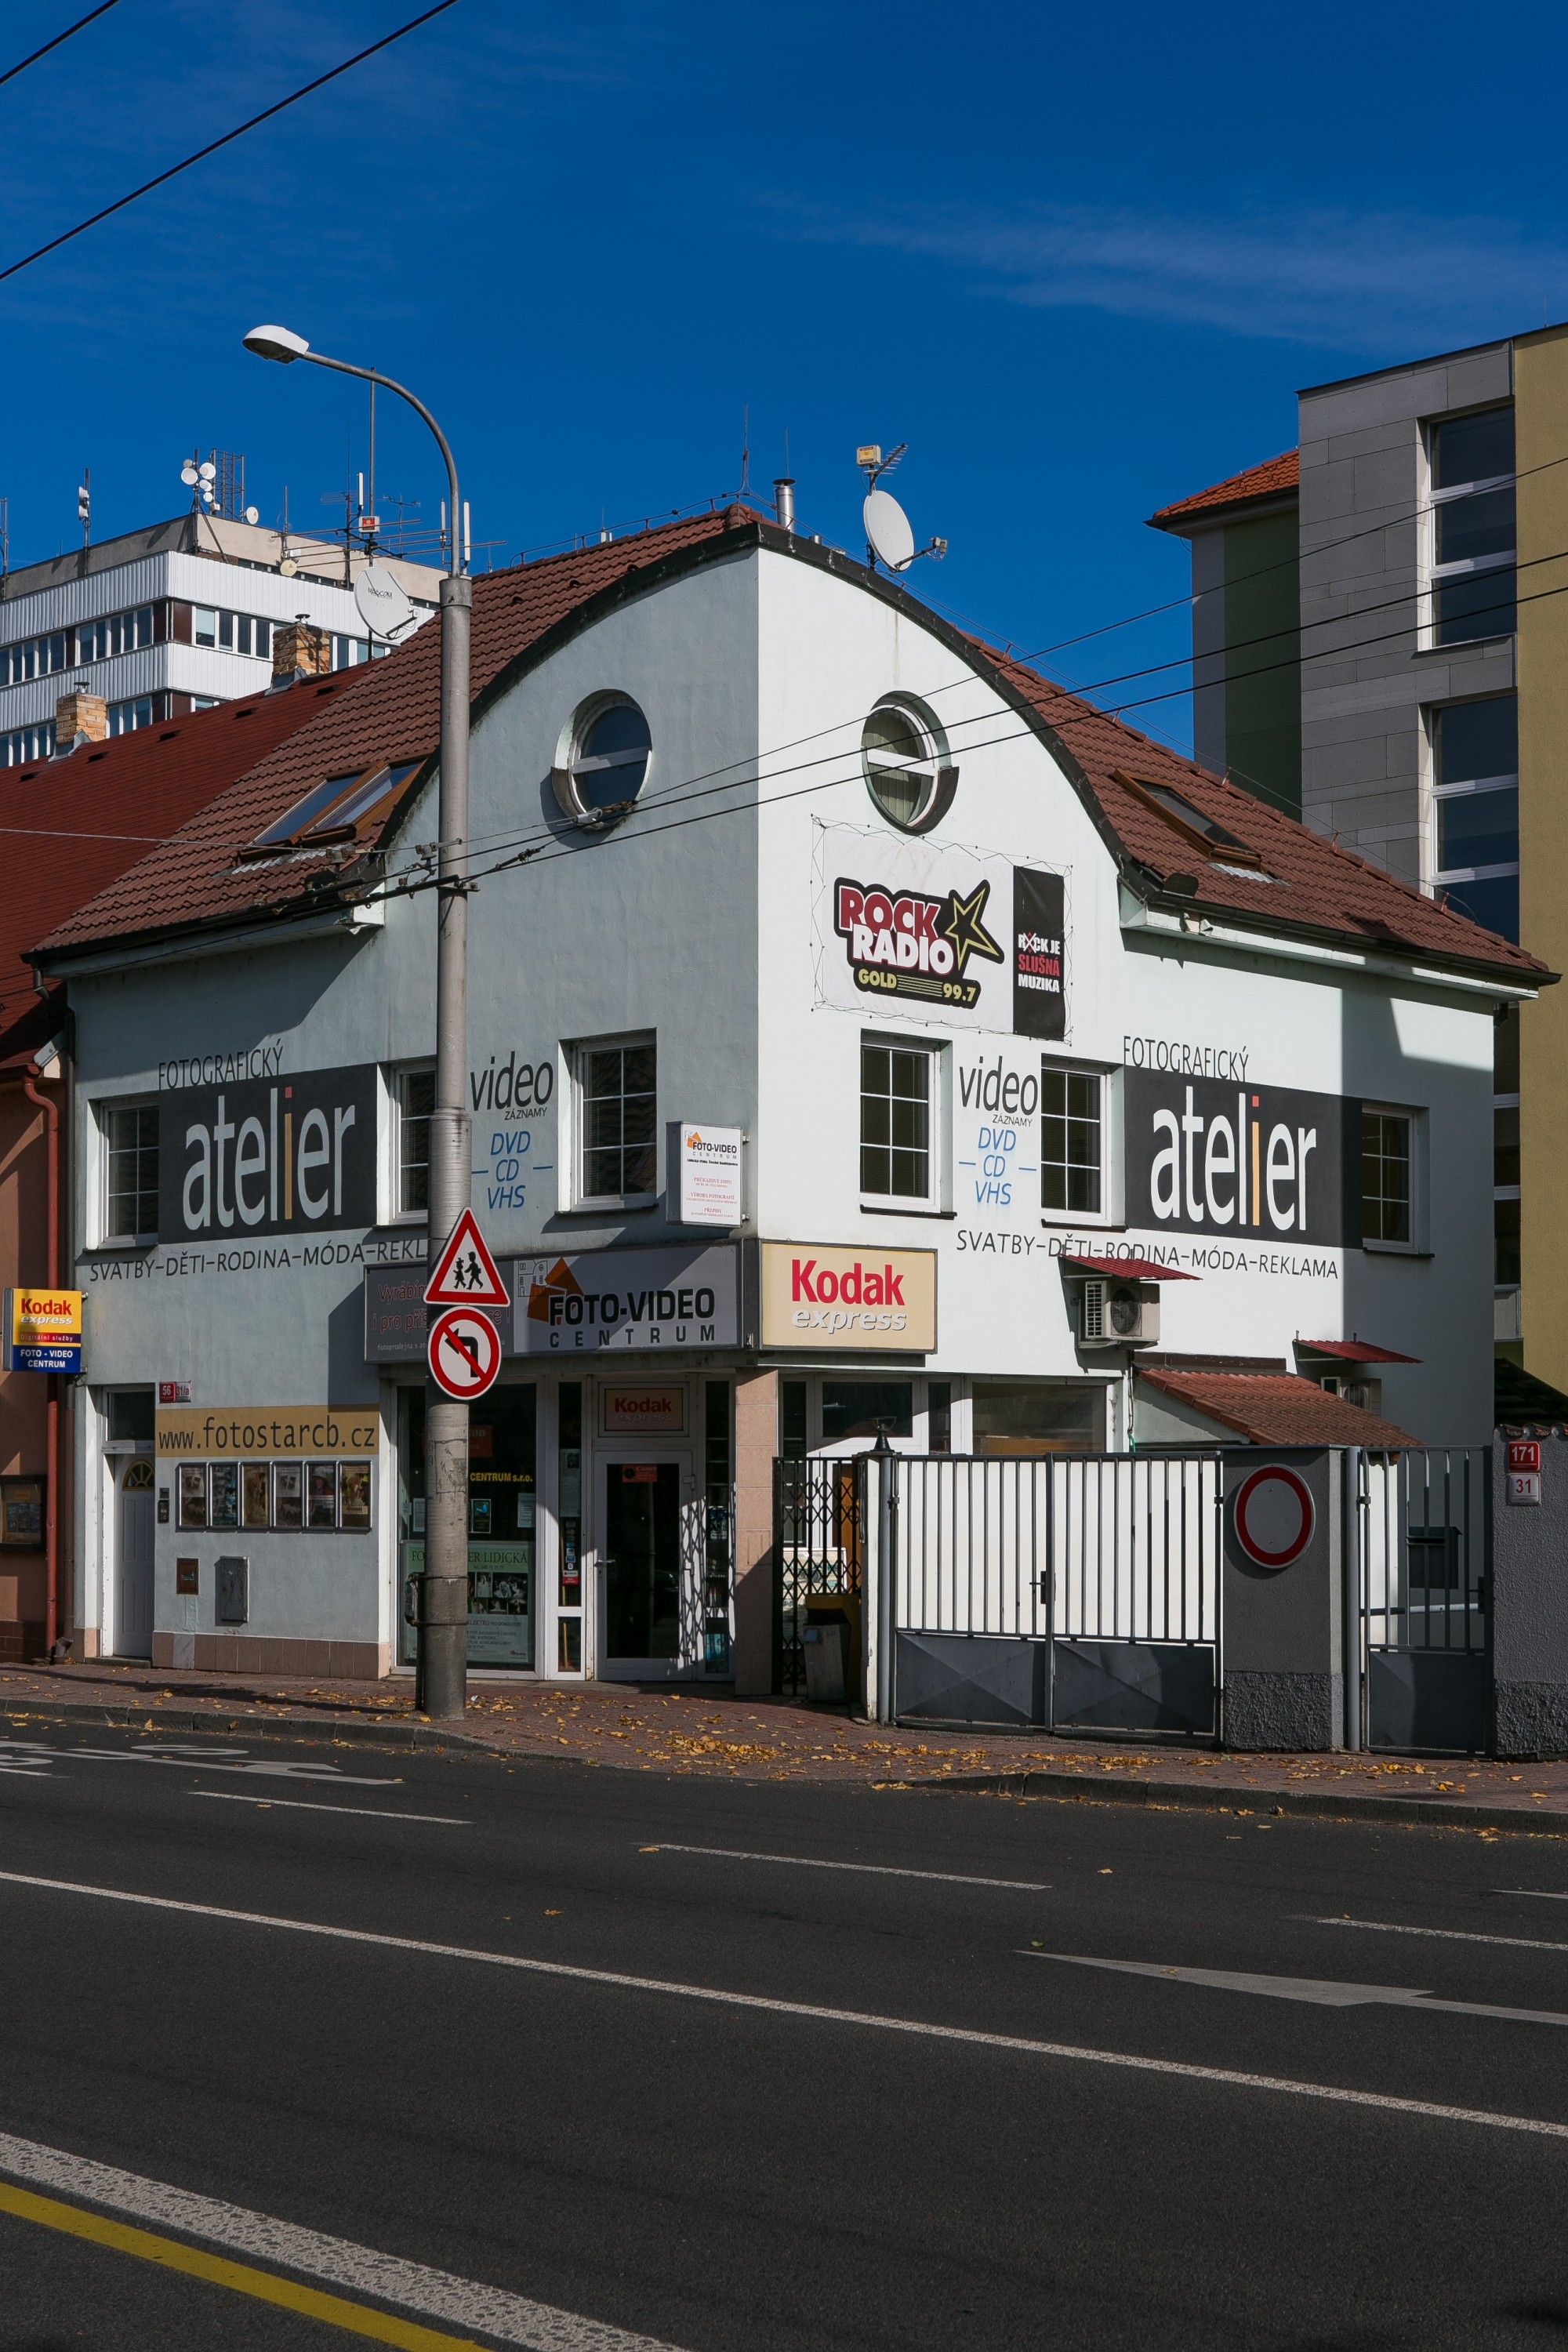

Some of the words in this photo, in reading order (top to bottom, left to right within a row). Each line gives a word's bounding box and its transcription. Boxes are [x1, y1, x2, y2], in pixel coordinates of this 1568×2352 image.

[839, 885, 941, 942] ROCK
[852, 923, 954, 975] RADIO
[1050, 940, 1061, 955] JE
[1018, 953, 1060, 977] SLUŠNÁ
[858, 968, 897, 989] GOLD
[943, 982, 976, 1002] 99.7
[1018, 973, 1060, 993] MUZIKA
[158, 1038, 284, 1091] FOTOGRAFICKÝ
[1123, 1036, 1249, 1083] FOTOGRAFICKÝ
[470, 1051, 554, 1112] video
[959, 1055, 1038, 1116] video
[504, 1107, 547, 1121] ZÁZNAMY
[992, 1112, 1033, 1127] ZÁZNAMY
[490, 1131, 531, 1156] DVD
[692, 1142, 737, 1153] FOTO-VIDEO
[978, 1127, 1016, 1152] DVD
[183, 1086, 355, 1230] atelier
[983, 1154, 1006, 1178] CD
[1150, 1085, 1316, 1231] atelier
[495, 1159, 520, 1182] CD
[488, 1185, 526, 1210] VHS
[975, 1180, 1012, 1205] VHS
[378, 1279, 427, 1305] Vyrábím
[792, 1259, 906, 1306] Kodak
[21, 1298, 72, 1316] Kodak
[550, 1287, 715, 1326] FOTO-VIDEO
[21, 1316, 73, 1326] express
[380, 1315, 401, 1334] pro
[405, 1308, 427, 1333] příš
[792, 1309, 907, 1334] express
[377, 1341, 412, 1352] fotoprodejna
[550, 1324, 715, 1348] CENTRUM
[27, 1359, 66, 1368] CENTRUM
[49, 1349, 73, 1358] VIDEO
[162, 1385, 171, 1396] 56
[615, 1398, 673, 1412] Kodak
[615, 1414, 673, 1422] express
[158, 1415, 375, 1450] www.fotostarcb.cz
[1512, 1446, 1534, 1461] 171
[470, 1472, 511, 1482] CENTRUM
[1515, 1479, 1531, 1494] 31
[484, 1550, 528, 1563] LIDICKÁ
